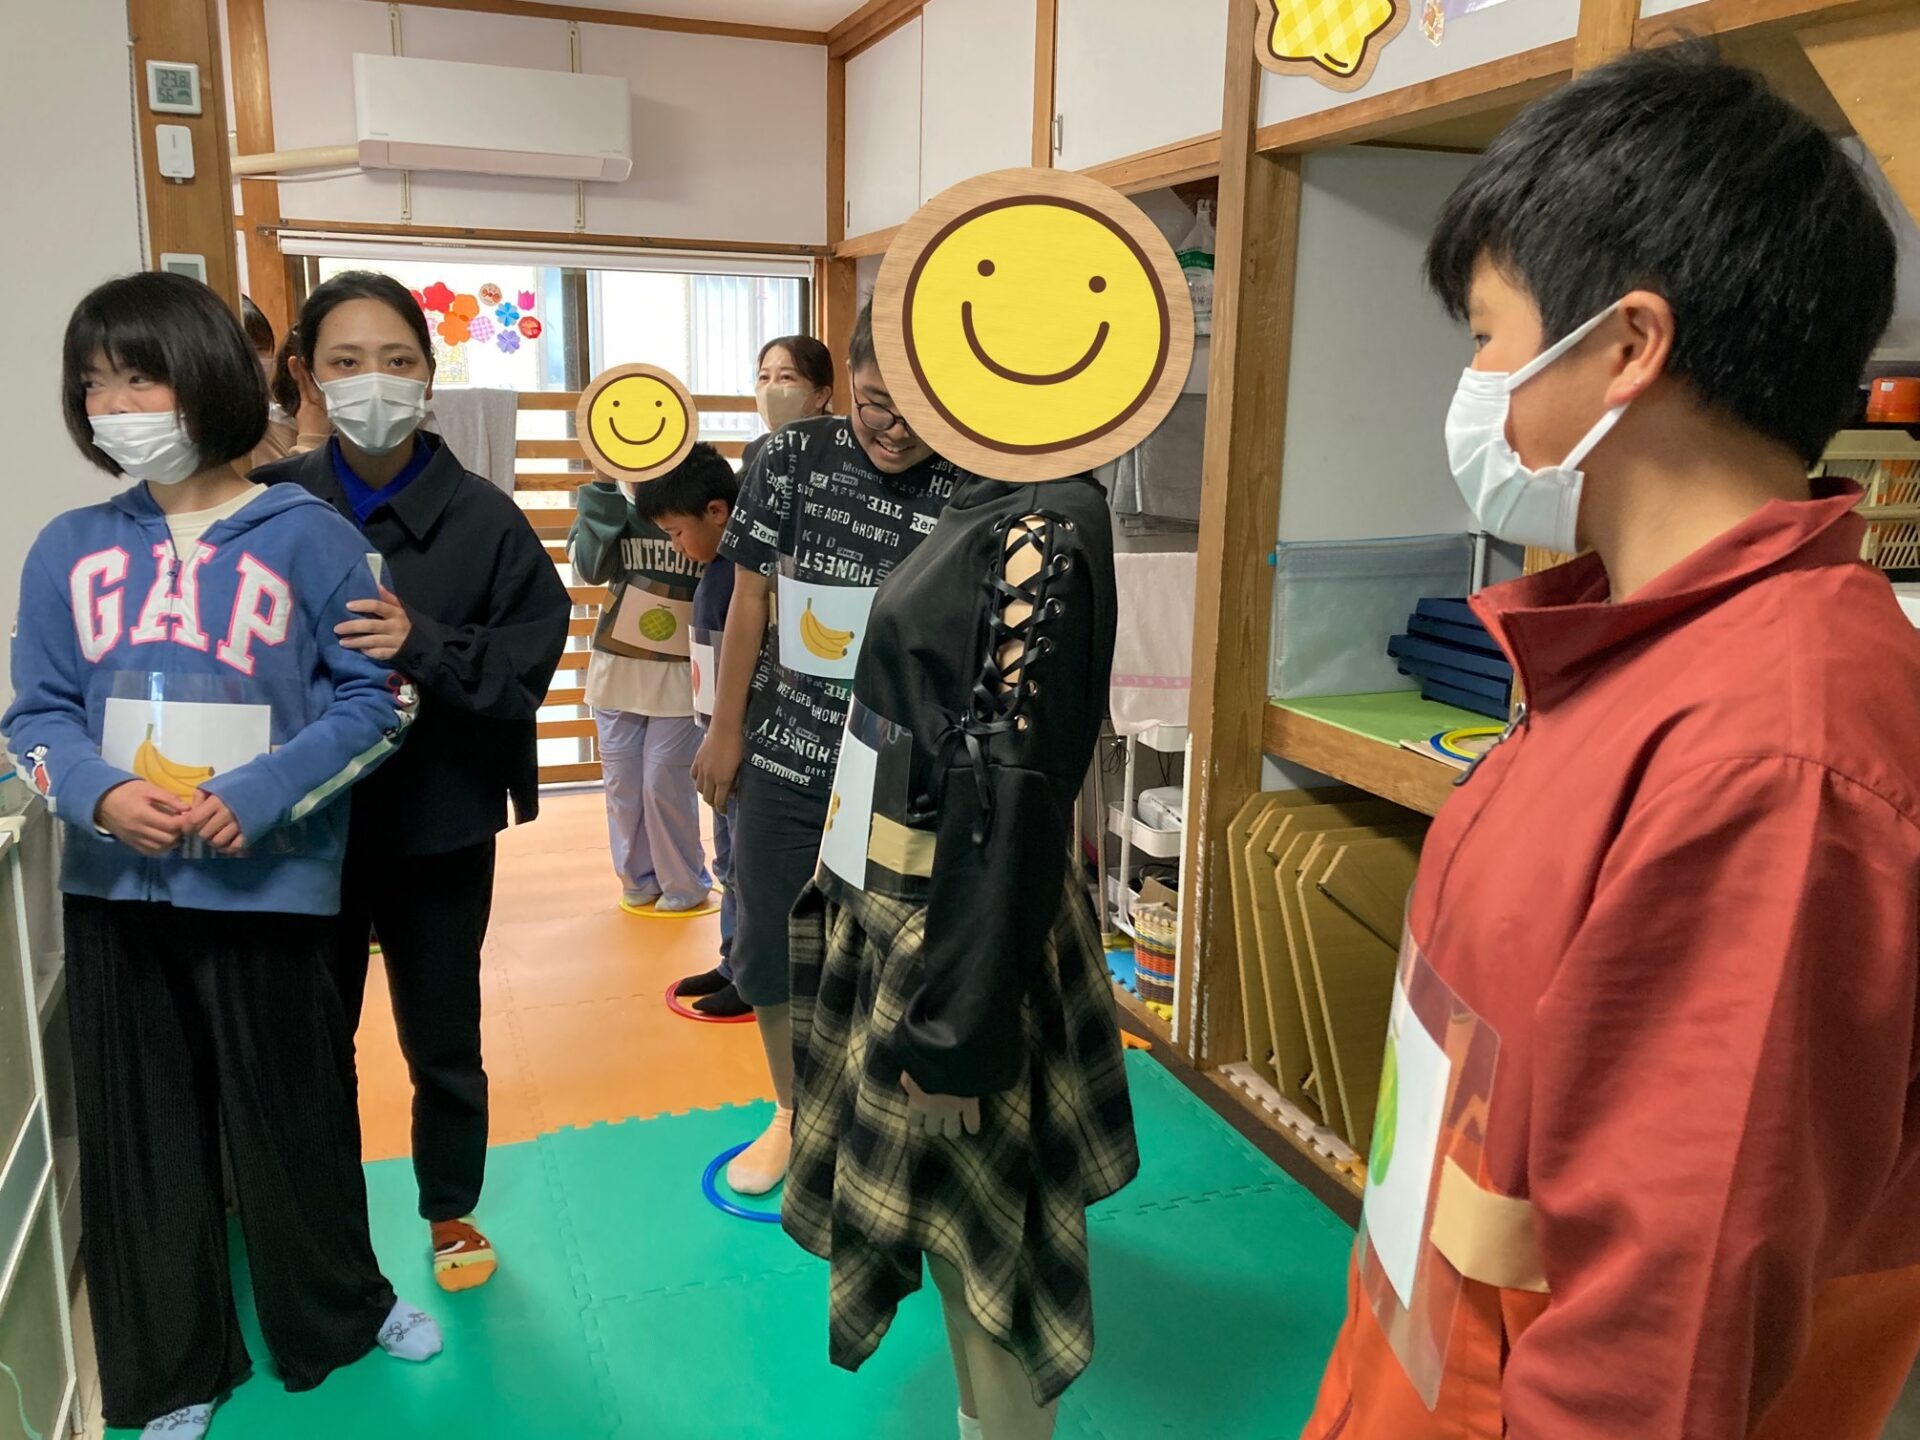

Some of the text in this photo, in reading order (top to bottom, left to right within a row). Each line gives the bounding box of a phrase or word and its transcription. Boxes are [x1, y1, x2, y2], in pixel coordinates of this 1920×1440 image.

[842, 461, 883, 484] Moment
[867, 495, 903, 520] THE
[804, 501, 824, 519] WEE
[824, 507, 850, 526] AGED
[852, 519, 901, 548] GROWTH
[802, 529, 837, 549] KID
[69, 540, 293, 676] GAP
[789, 689, 812, 708] AGED
[756, 718, 831, 764] HONESTY
[805, 765, 827, 777] DAYS
